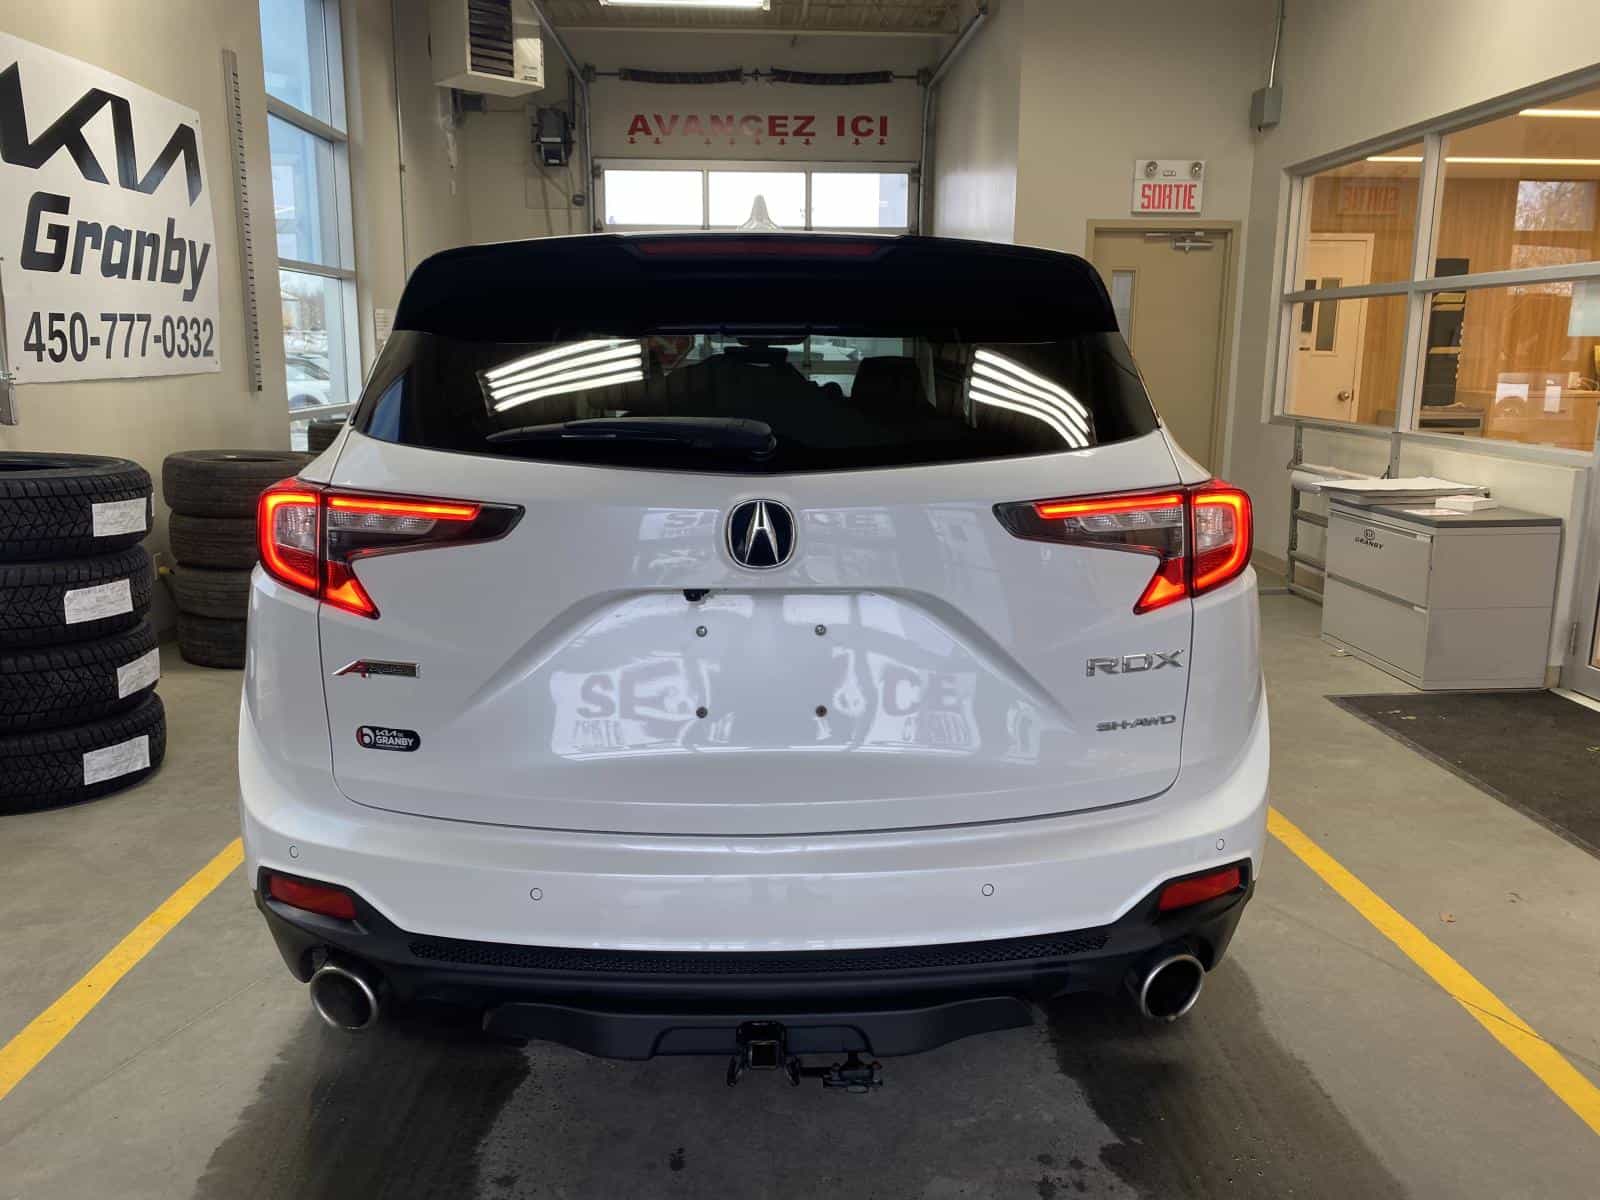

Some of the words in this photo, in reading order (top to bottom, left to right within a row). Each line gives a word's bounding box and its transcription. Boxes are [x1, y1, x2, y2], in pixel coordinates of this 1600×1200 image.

[627, 114, 816, 137] AVANCEZ
[836, 115, 889, 137] ICI
[1140, 183, 1198, 210] SORTIE
[20, 191, 211, 302] Granby
[24, 311, 214, 362] 450-777-0332
[1086, 649, 1185, 677] RDX
[1095, 714, 1177, 732] SH-AWD
[376, 736, 415, 747] GRANBY
